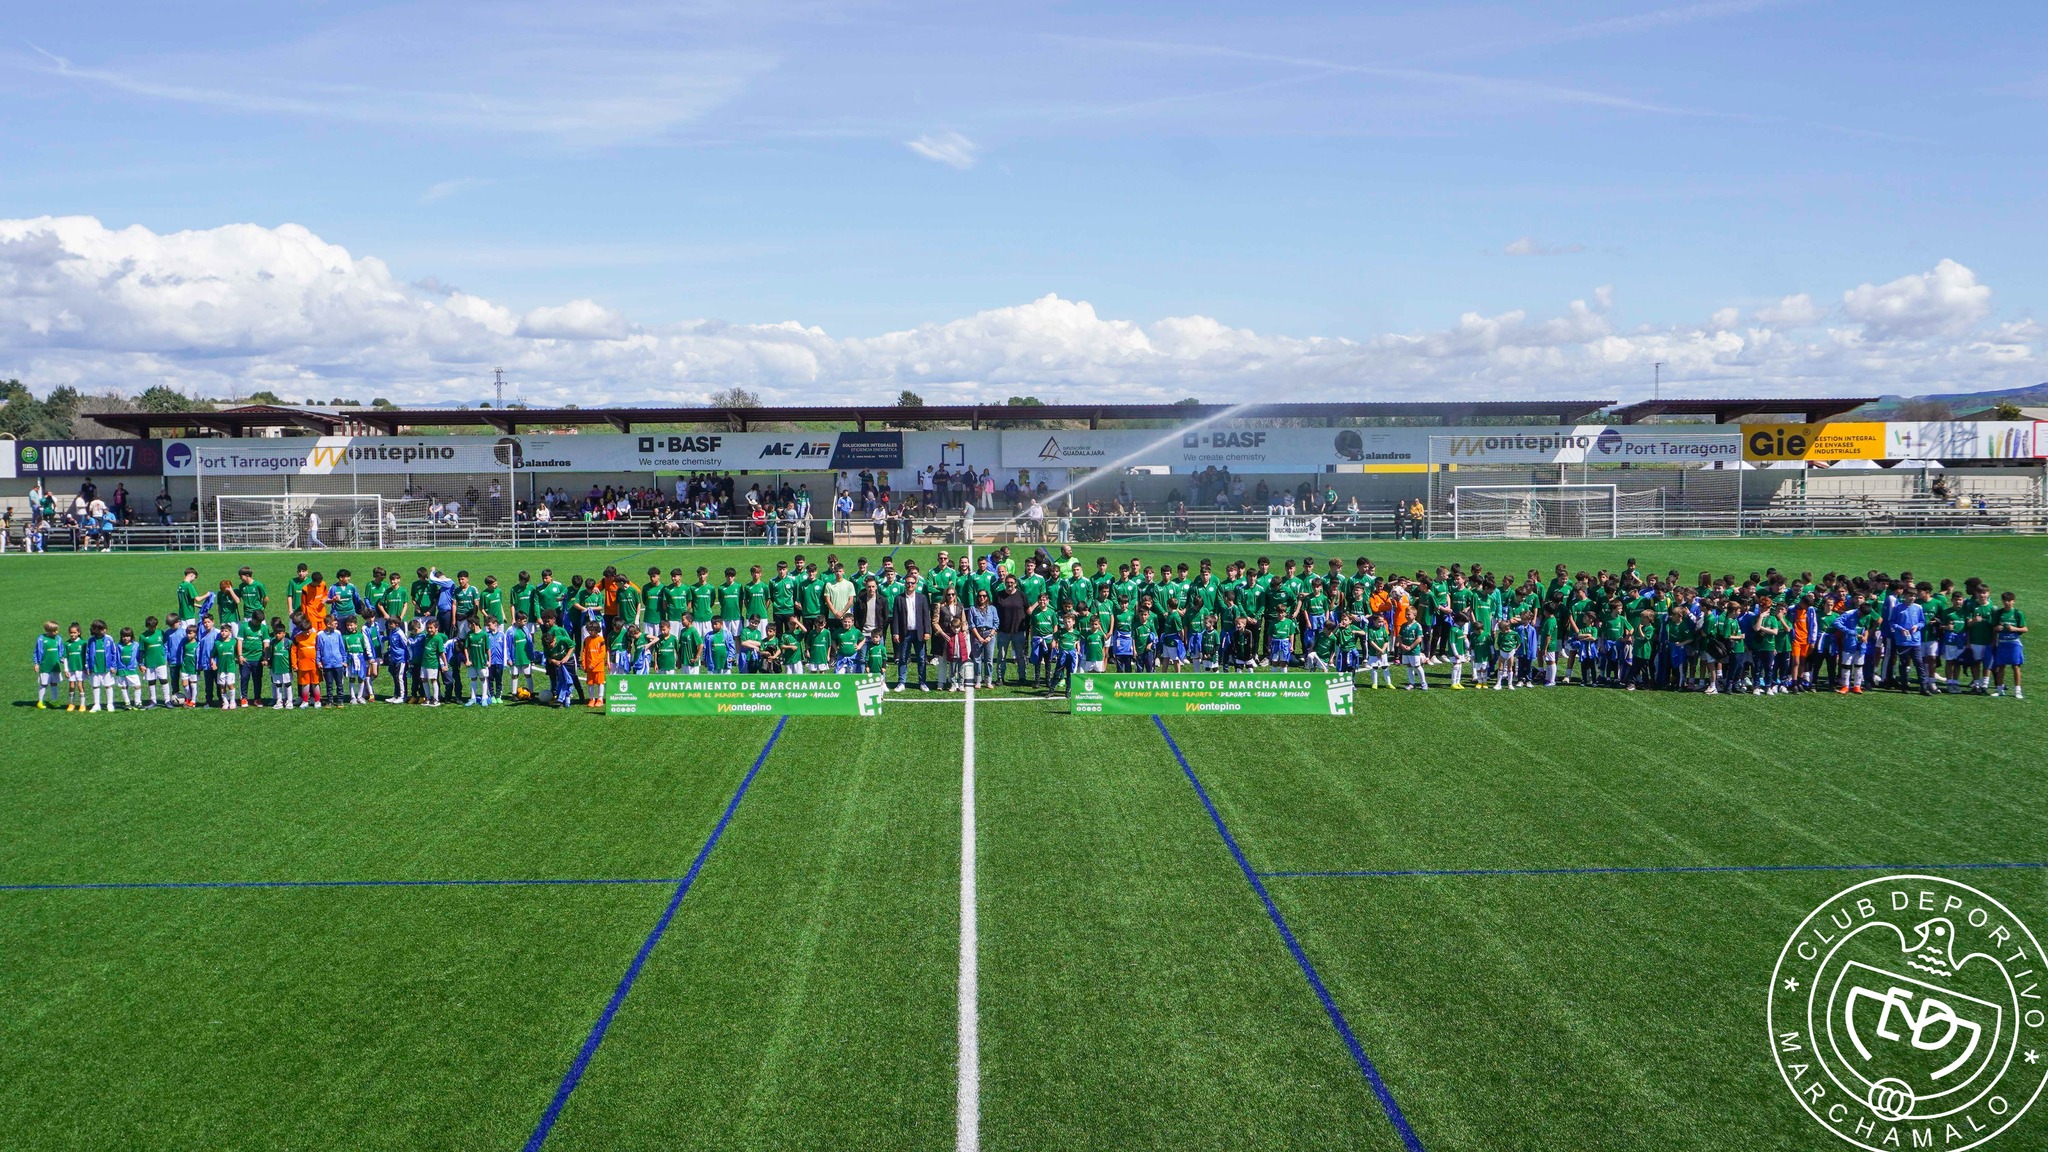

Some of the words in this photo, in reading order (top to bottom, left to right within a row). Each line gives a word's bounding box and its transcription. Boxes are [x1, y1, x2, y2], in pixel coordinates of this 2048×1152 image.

[668, 436, 722, 453] BASF
[1212, 431, 1266, 448] BASF
[1750, 428, 1806, 457] Gie
[759, 442, 794, 459] MC
[1625, 442, 1656, 455] Port
[1660, 441, 1737, 456] Tarragona
[43, 446, 133, 470] IMPULSO27
[230, 455, 307, 470] Tarragona
[639, 458, 652, 466] We
[654, 458, 679, 466] create
[681, 457, 722, 467] chemistry
[1183, 453, 1197, 461] We
[1198, 453, 1223, 461] create
[1225, 453, 1266, 462] chemistry
[648, 681, 737, 690] AYUNTAMIENTO
[741, 681, 755, 690] DE
[760, 681, 841, 690] MARCHAMALO
[1114, 680, 1205, 689] AYUNTAMIENTO
[1209, 680, 1224, 689] DE
[1229, 680, 1312, 689] MARCHAMALO
